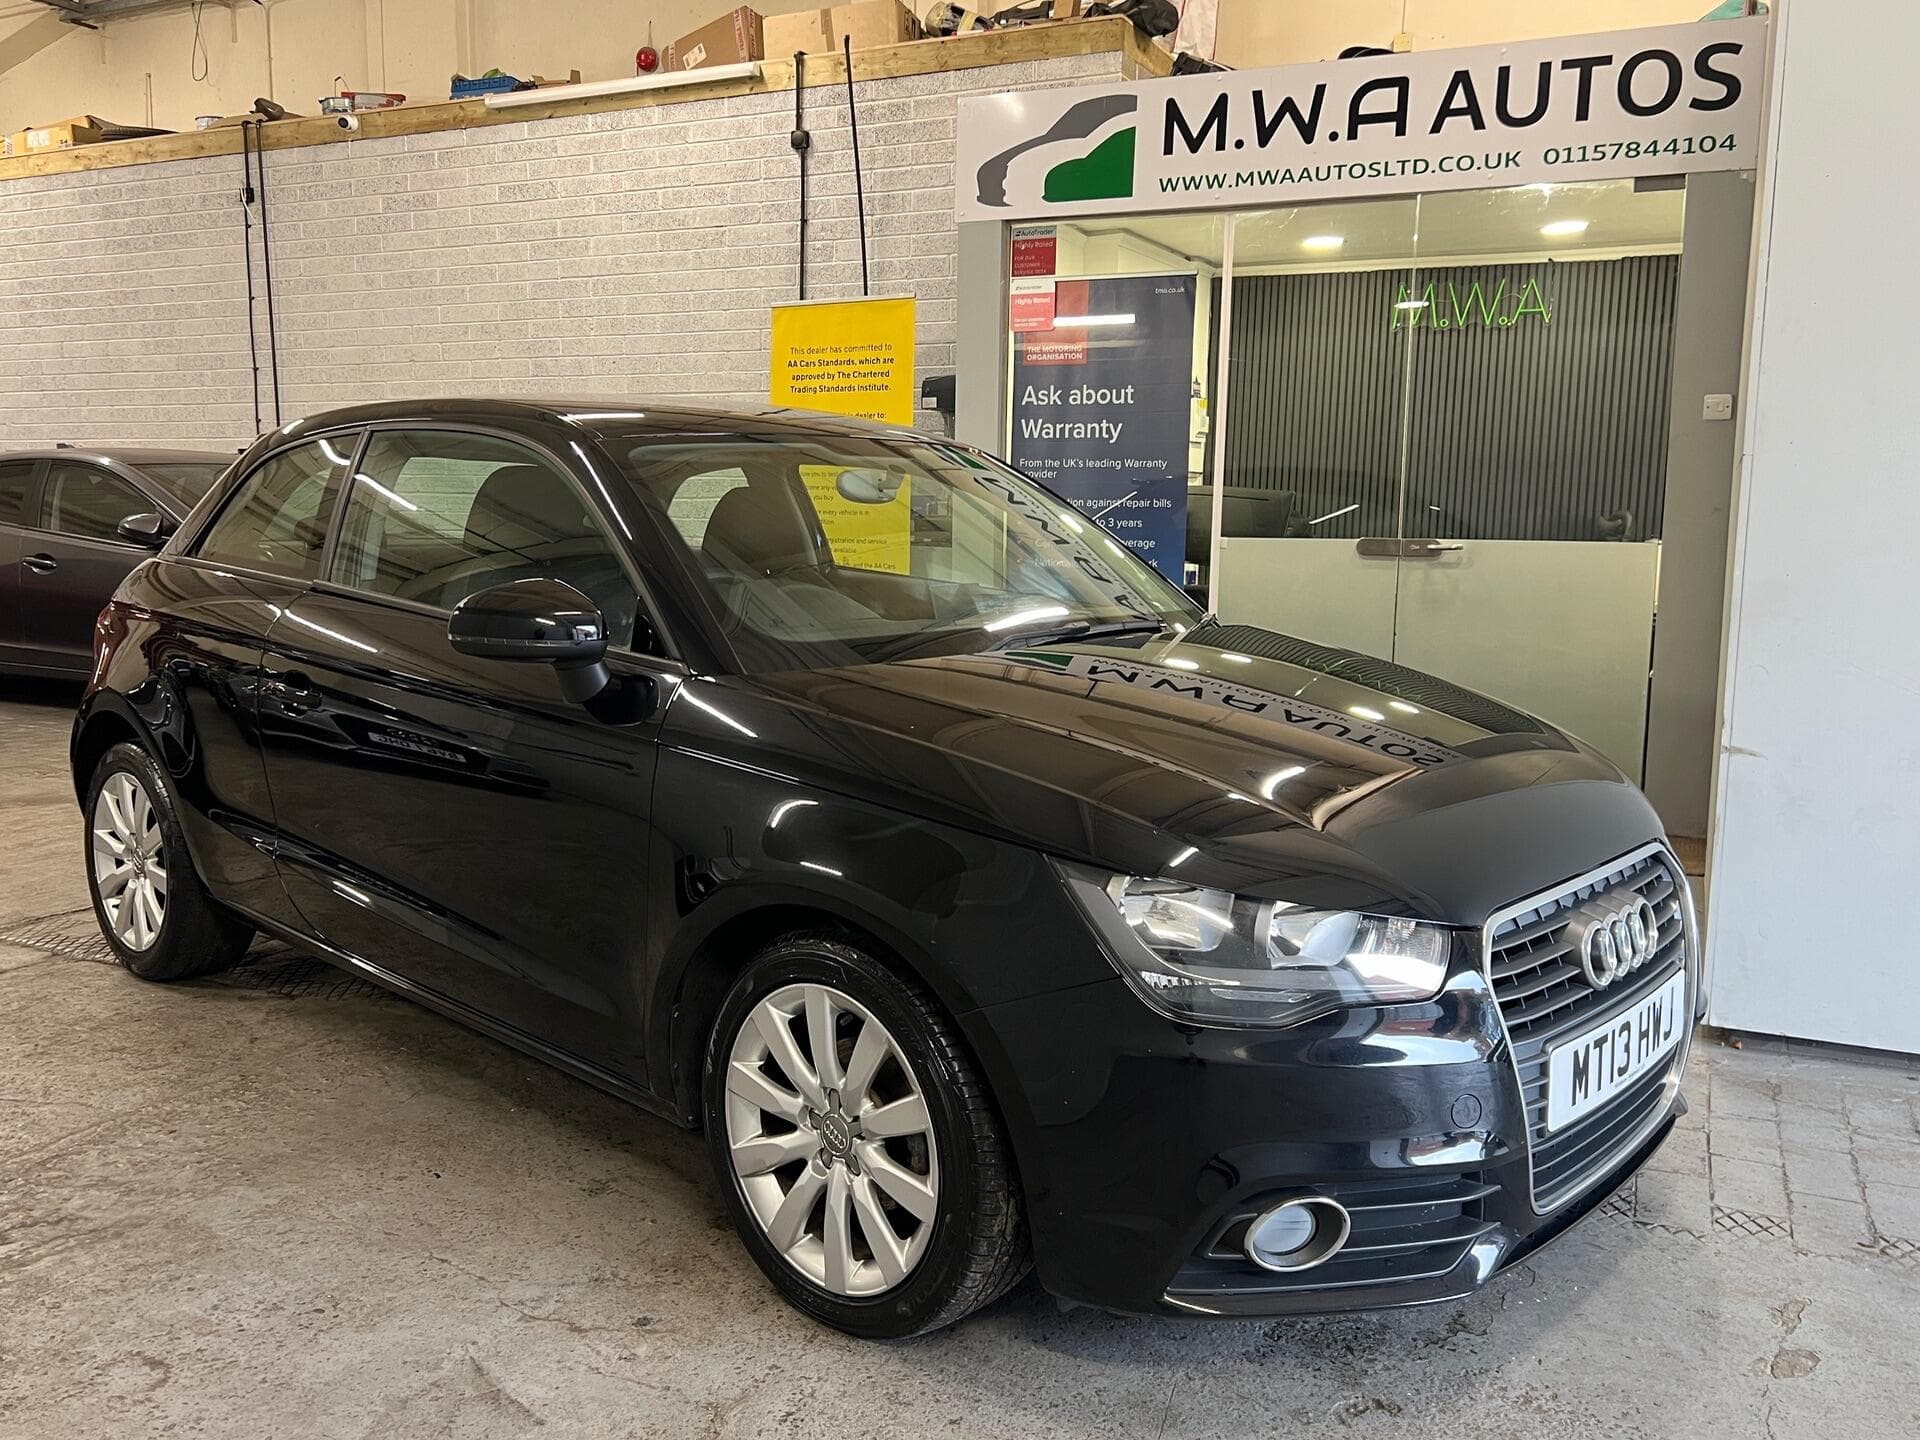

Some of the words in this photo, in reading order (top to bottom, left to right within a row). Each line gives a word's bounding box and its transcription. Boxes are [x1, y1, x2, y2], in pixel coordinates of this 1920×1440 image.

[1163, 76, 1410, 156] M.W.A
[1429, 42, 1744, 135] AUTOS
[1159, 150, 1521, 193] WWW.MWAAUTOSLTD.CO.UK
[1543, 133, 1738, 165] 01157844104
[1393, 279, 1550, 329] M.W.A
[790, 347, 805, 356] This
[807, 346, 828, 355] dealer
[830, 345, 842, 353] has
[844, 343, 883, 353] committed
[885, 343, 893, 351] to
[1044, 344, 1082, 352] MOTORING
[787, 360, 798, 368] AA
[799, 359, 816, 368] Cars
[818, 358, 857, 367] Standards,
[859, 356, 881, 365] which
[882, 357, 894, 365] are
[1027, 353, 1083, 361] ORGANISATION
[792, 371, 826, 382] approved
[827, 371, 835, 381] by
[837, 370, 851, 379] The
[852, 369, 890, 379] Chartered
[790, 385, 817, 395] Trading
[819, 383, 856, 393] Standards
[858, 383, 892, 392] Institute.
[1021, 385, 1063, 405] Ask
[1069, 385, 1134, 405] about
[1021, 419, 1123, 443] Warranty
[1020, 459, 1042, 467] From
[1045, 458, 1060, 467] the
[1063, 458, 1083, 467] UK's
[1086, 459, 1121, 469] leading
[1124, 459, 1168, 470] Warranty
[1086, 499, 1121, 509] against
[1122, 499, 1151, 510] repair
[1153, 498, 1172, 508] bills
[1108, 518, 1114, 527] 3
[1117, 520, 1142, 530] years
[1571, 1020, 1631, 1107] MT13
[1637, 986, 1675, 1063] HWJ
